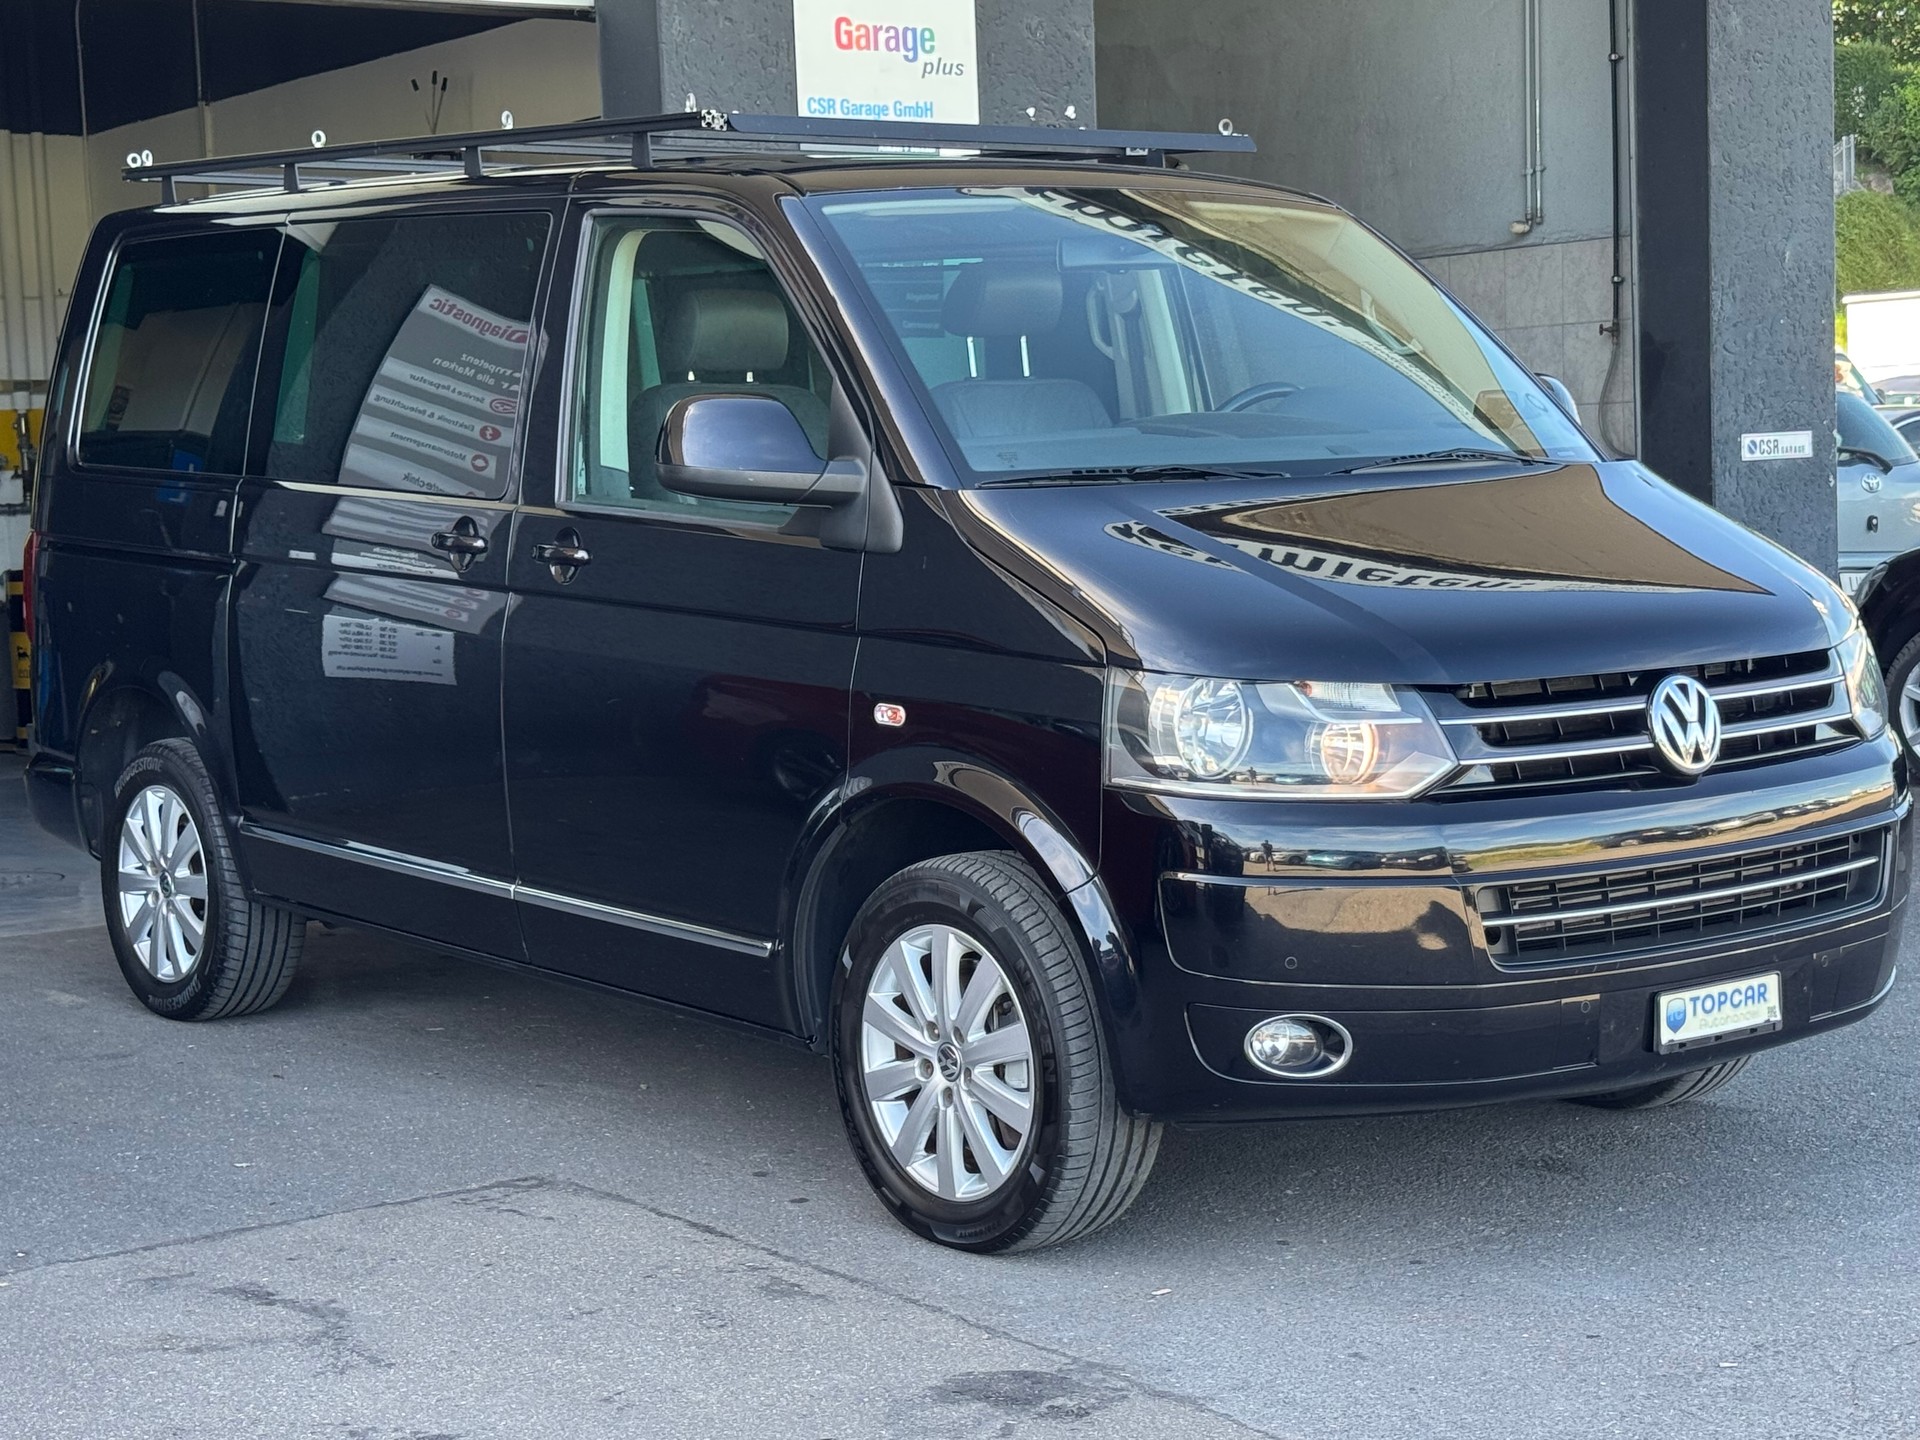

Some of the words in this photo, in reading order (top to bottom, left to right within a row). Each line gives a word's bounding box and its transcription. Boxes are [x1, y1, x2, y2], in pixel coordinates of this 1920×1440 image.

[834, 16, 936, 63] Garage
[920, 57, 965, 79] plus
[807, 97, 836, 115] CSR
[840, 98, 889, 120] Garage
[893, 100, 934, 119] GmbH
[1759, 439, 1779, 455] CSR
[1688, 982, 1768, 1017] TOPCAR
